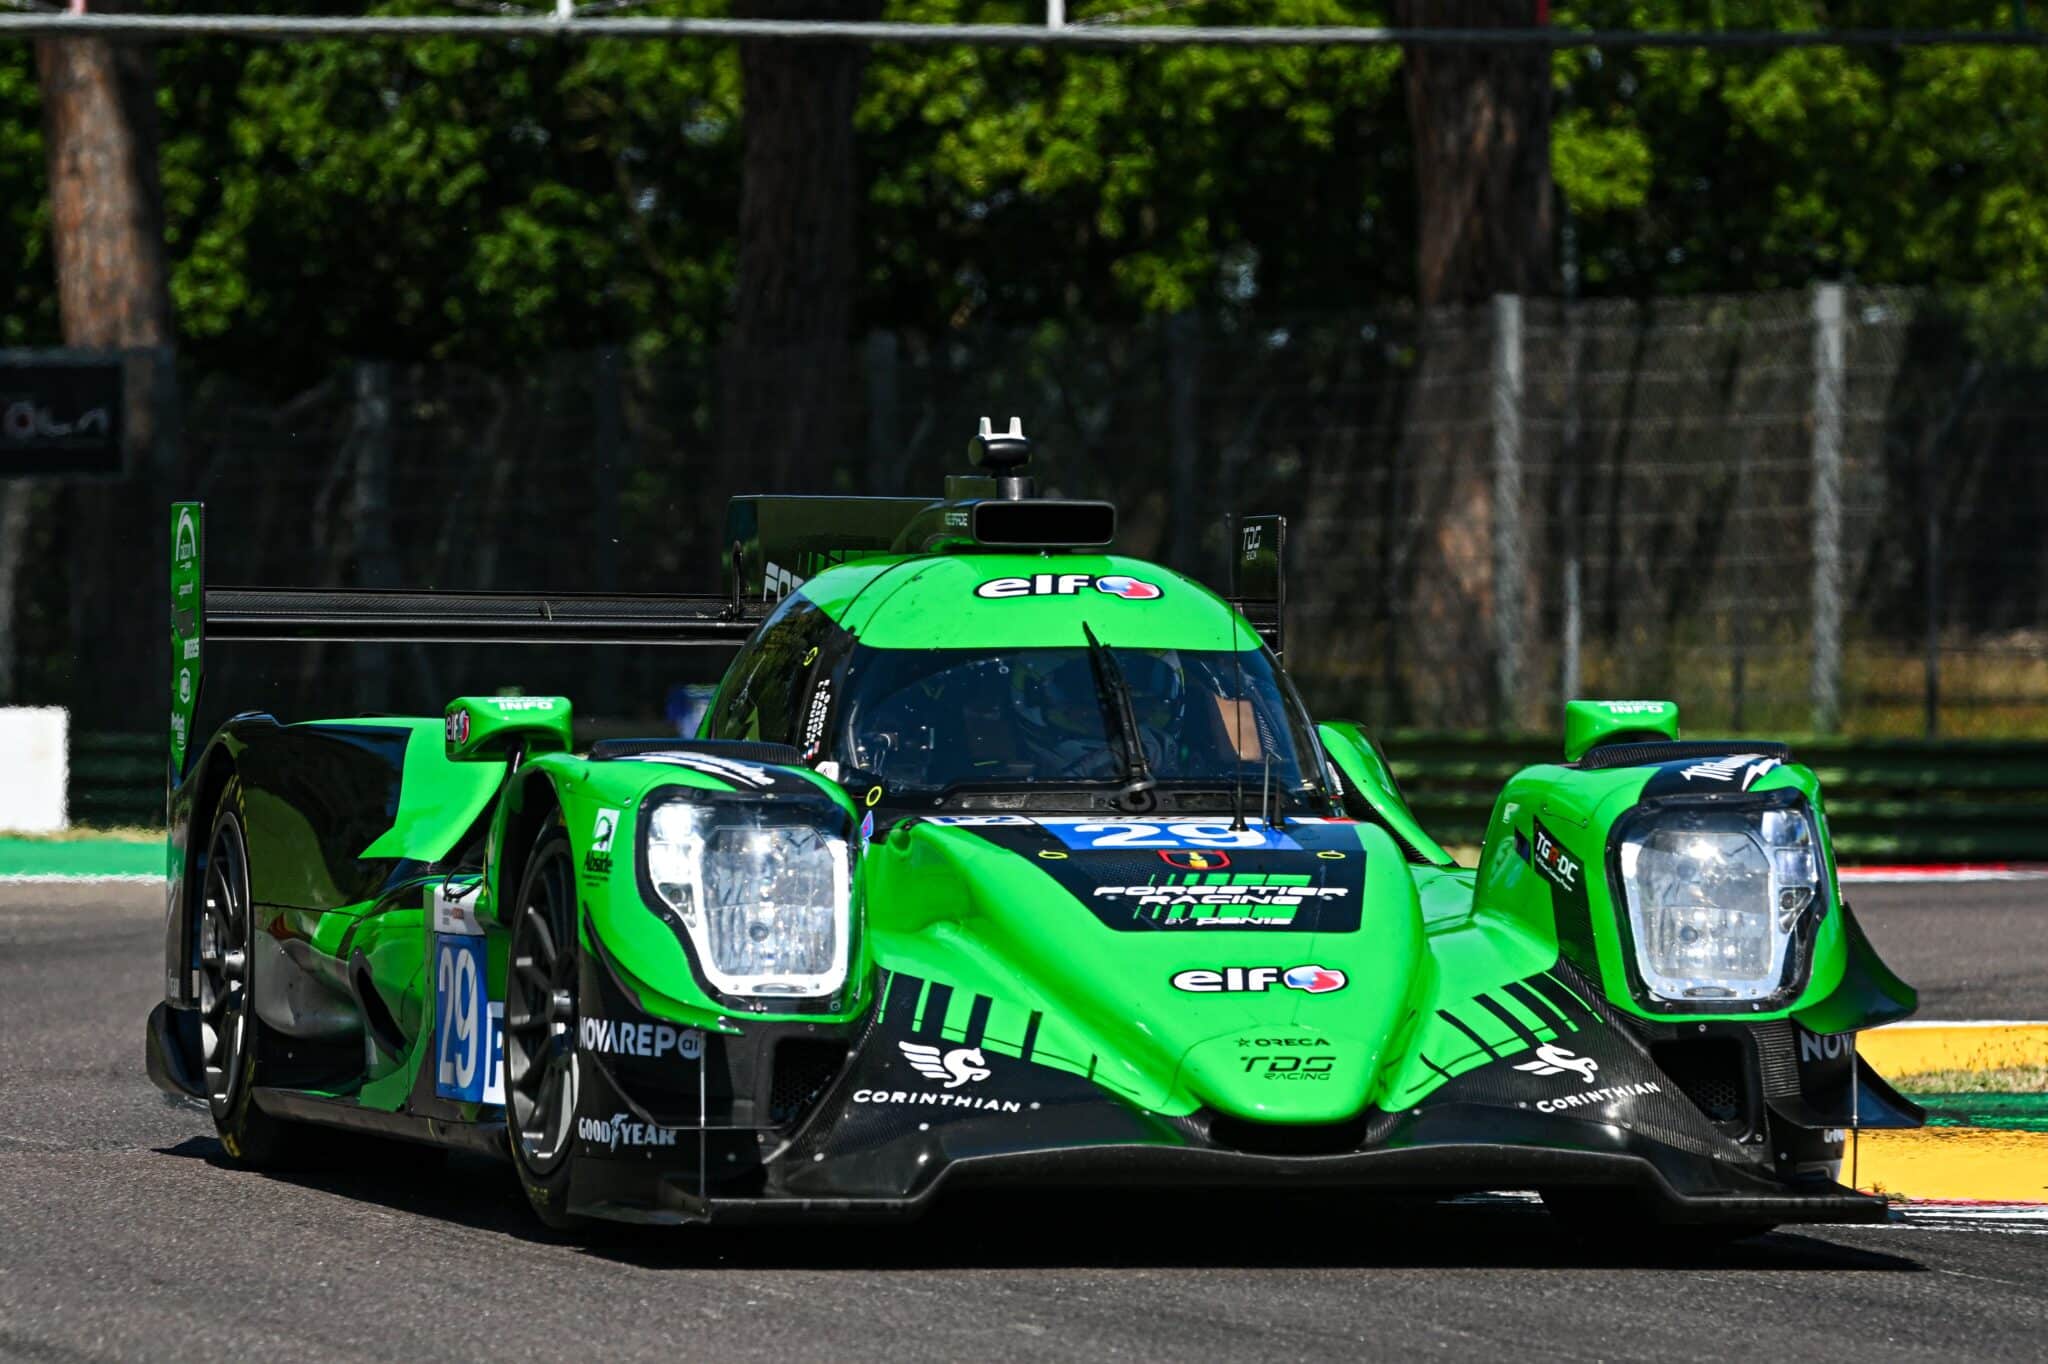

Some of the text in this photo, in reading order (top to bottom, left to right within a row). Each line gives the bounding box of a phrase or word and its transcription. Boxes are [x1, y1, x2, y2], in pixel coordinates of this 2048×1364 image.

[976, 574, 1091, 598] elf
[1074, 823, 1266, 848] 29
[1093, 885, 1349, 897] FORESTIER
[1138, 894, 1303, 905] RACING
[1172, 967, 1279, 992] elf
[438, 946, 479, 1089] 29
[1254, 1038, 1331, 1047] ORECA
[1239, 1056, 1337, 1073] TDS
[1263, 1072, 1331, 1081] RACING
[852, 1089, 1021, 1113] CORINTHIAN
[1536, 1080, 1661, 1113] CORINTHIAN
[578, 1113, 677, 1146] GOODYEAR
